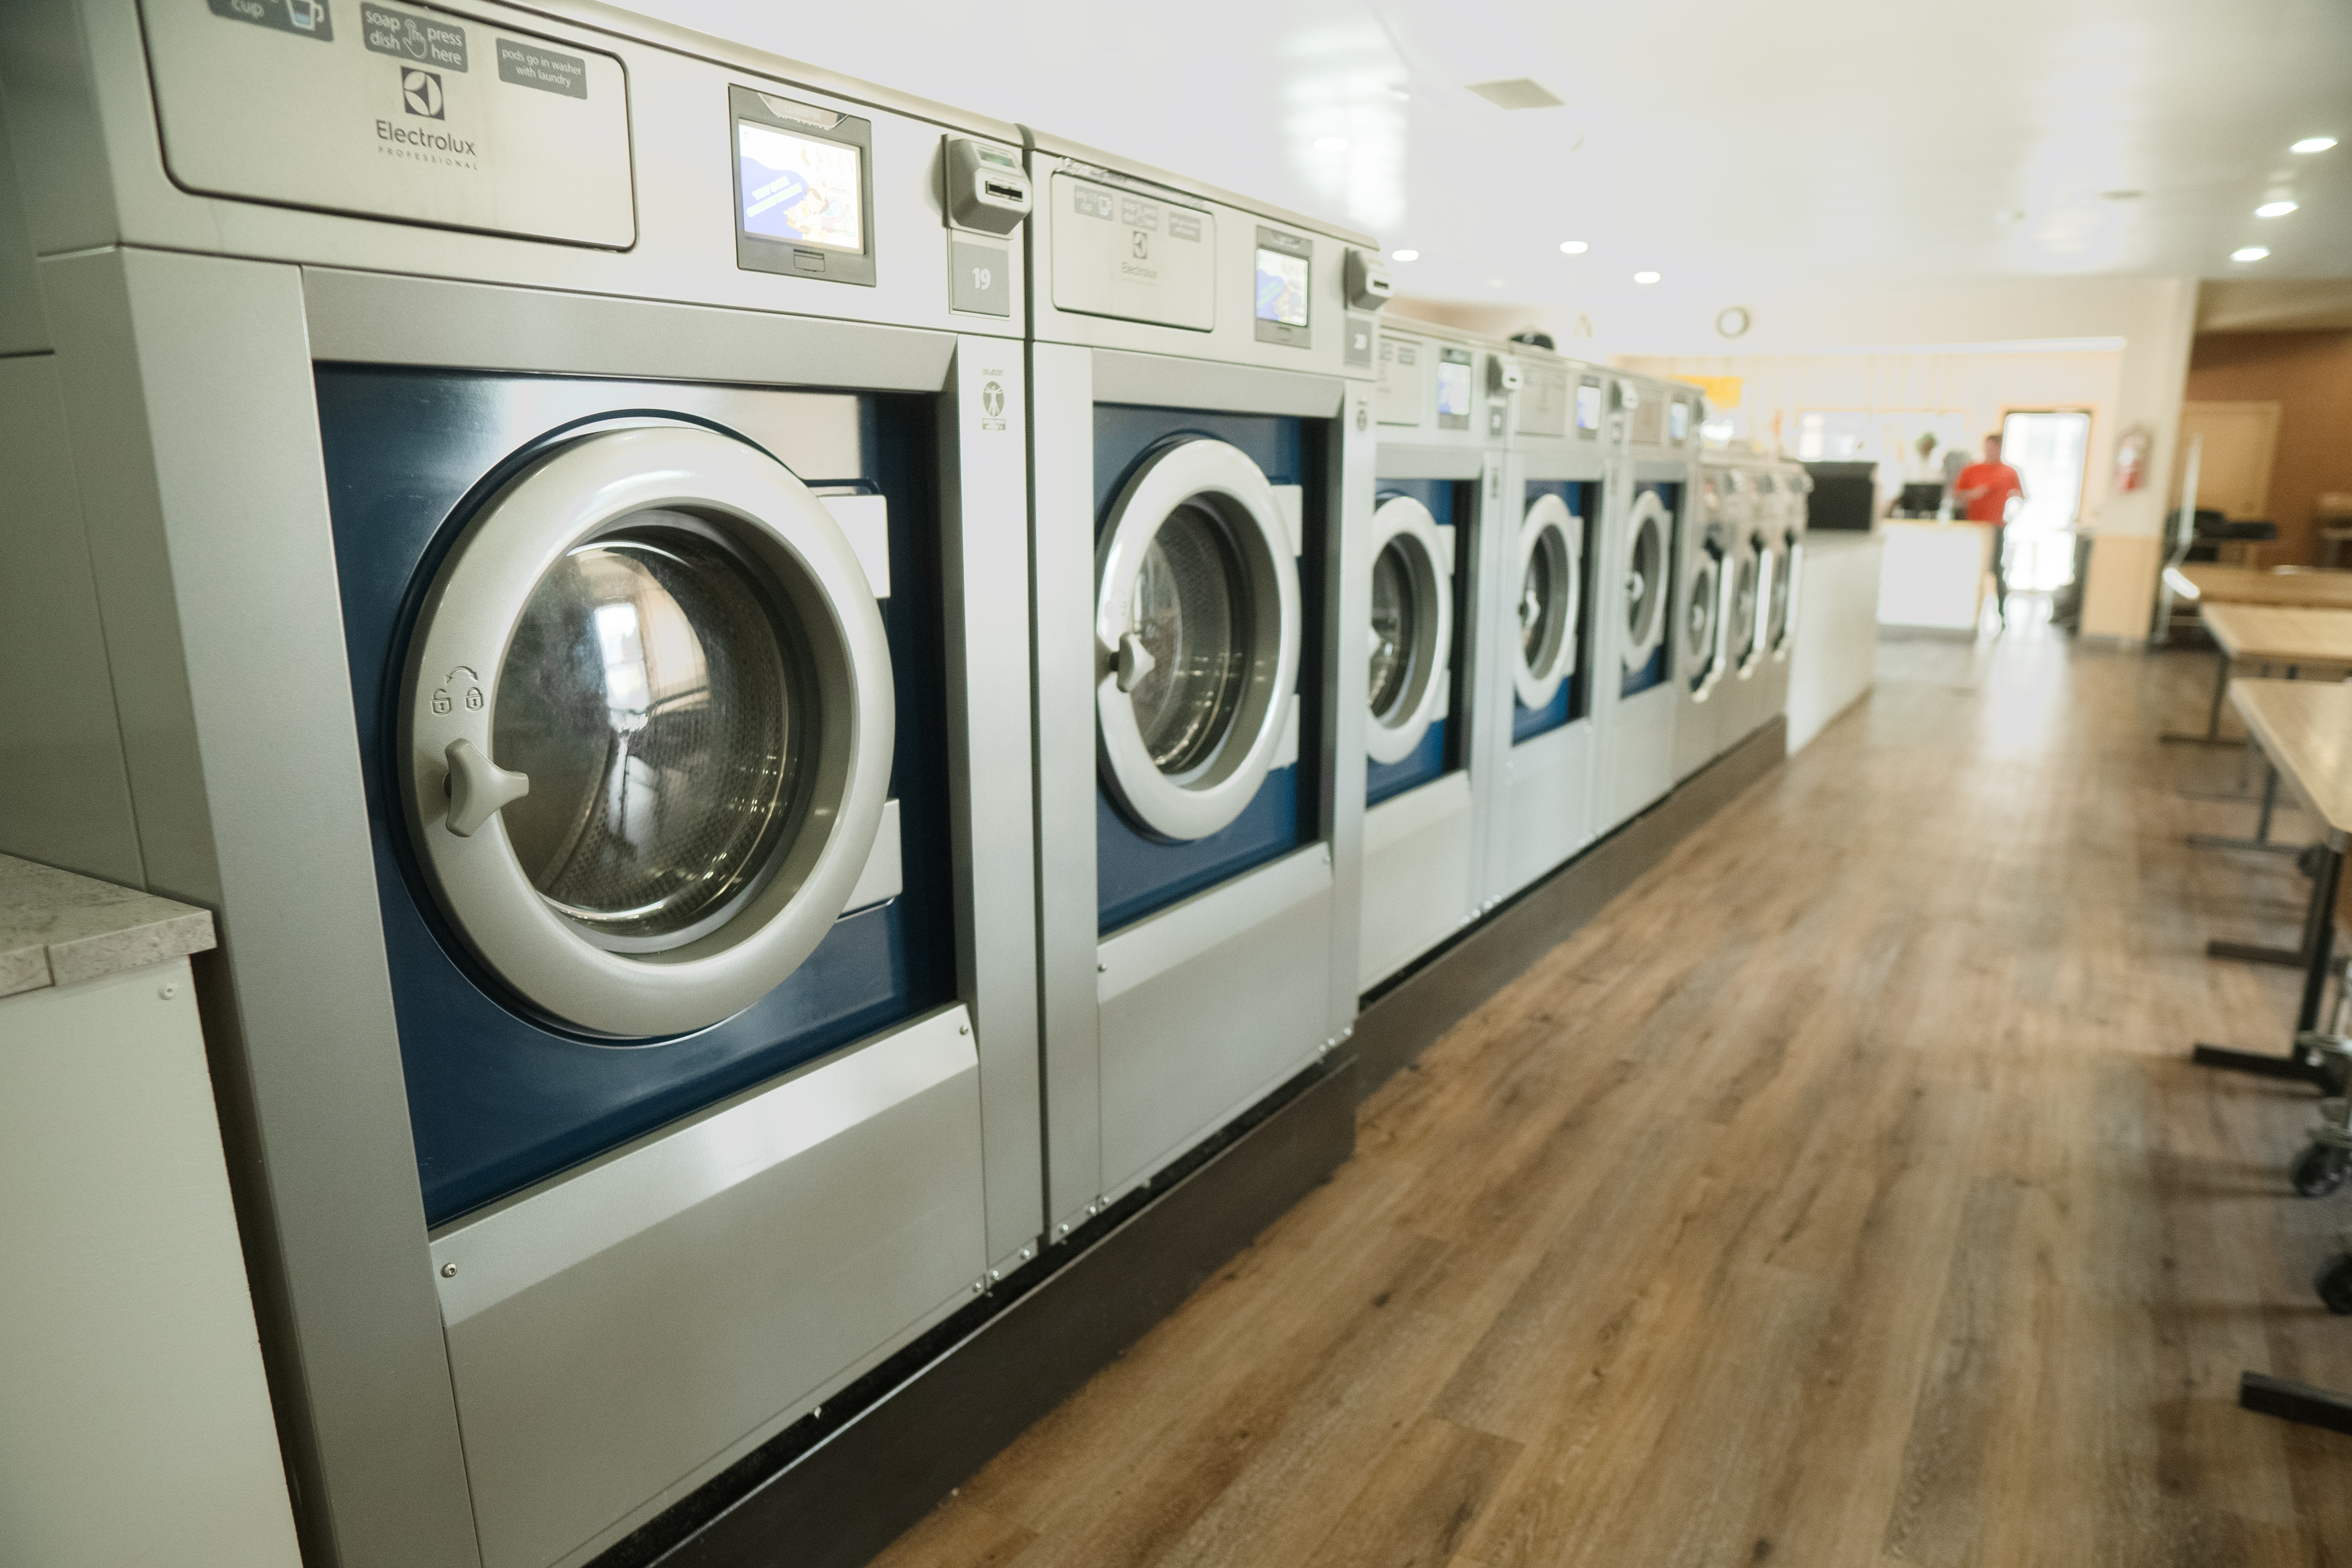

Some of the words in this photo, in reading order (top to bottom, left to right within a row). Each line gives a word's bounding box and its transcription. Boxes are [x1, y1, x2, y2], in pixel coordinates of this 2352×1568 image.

[365, 11, 401, 33] soap
[370, 29, 401, 51] dish
[427, 27, 463, 47] press
[431, 42, 462, 65] here
[502, 49, 525, 62] pods
[526, 55, 539, 66] go
[541, 56, 550, 68] in
[551, 61, 582, 75] washer
[516, 66, 537, 79] with
[538, 68, 571, 89] laundry
[376, 119, 476, 157] Electrolux
[377, 145, 478, 170] PROFESSIONAL
[752, 184, 771, 201] TRY
[769, 175, 790, 192] OUR
[972, 267, 992, 289] 19
